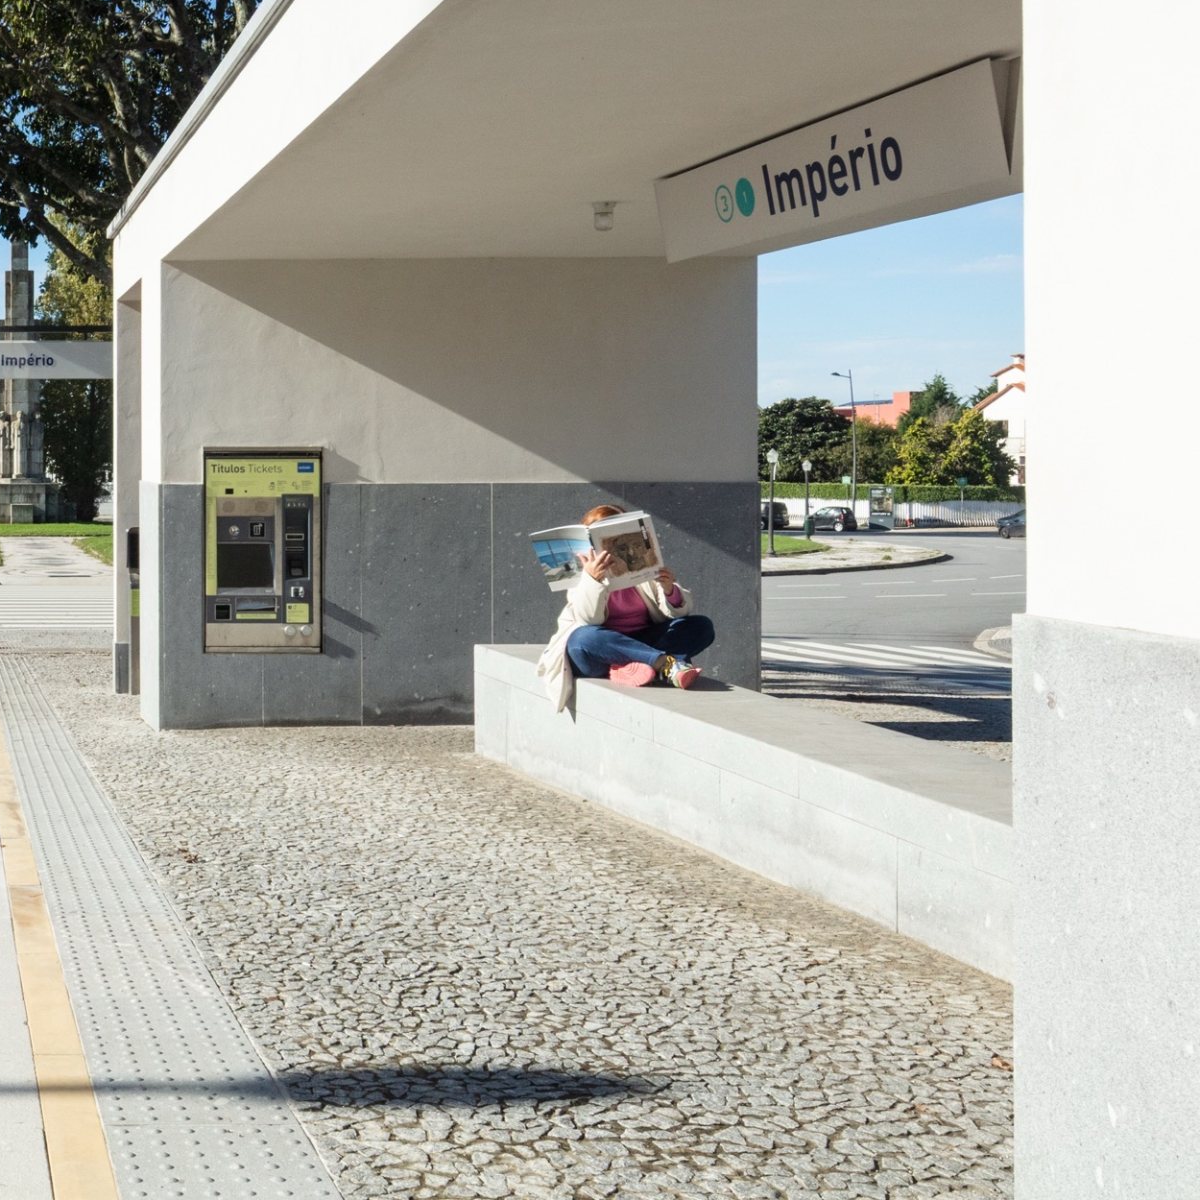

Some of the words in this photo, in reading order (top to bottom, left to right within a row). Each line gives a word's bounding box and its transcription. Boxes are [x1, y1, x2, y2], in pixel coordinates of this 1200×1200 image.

[761, 128, 903, 218] Império
[1, 353, 54, 368] Império
[248, 463, 283, 473] Tickets
